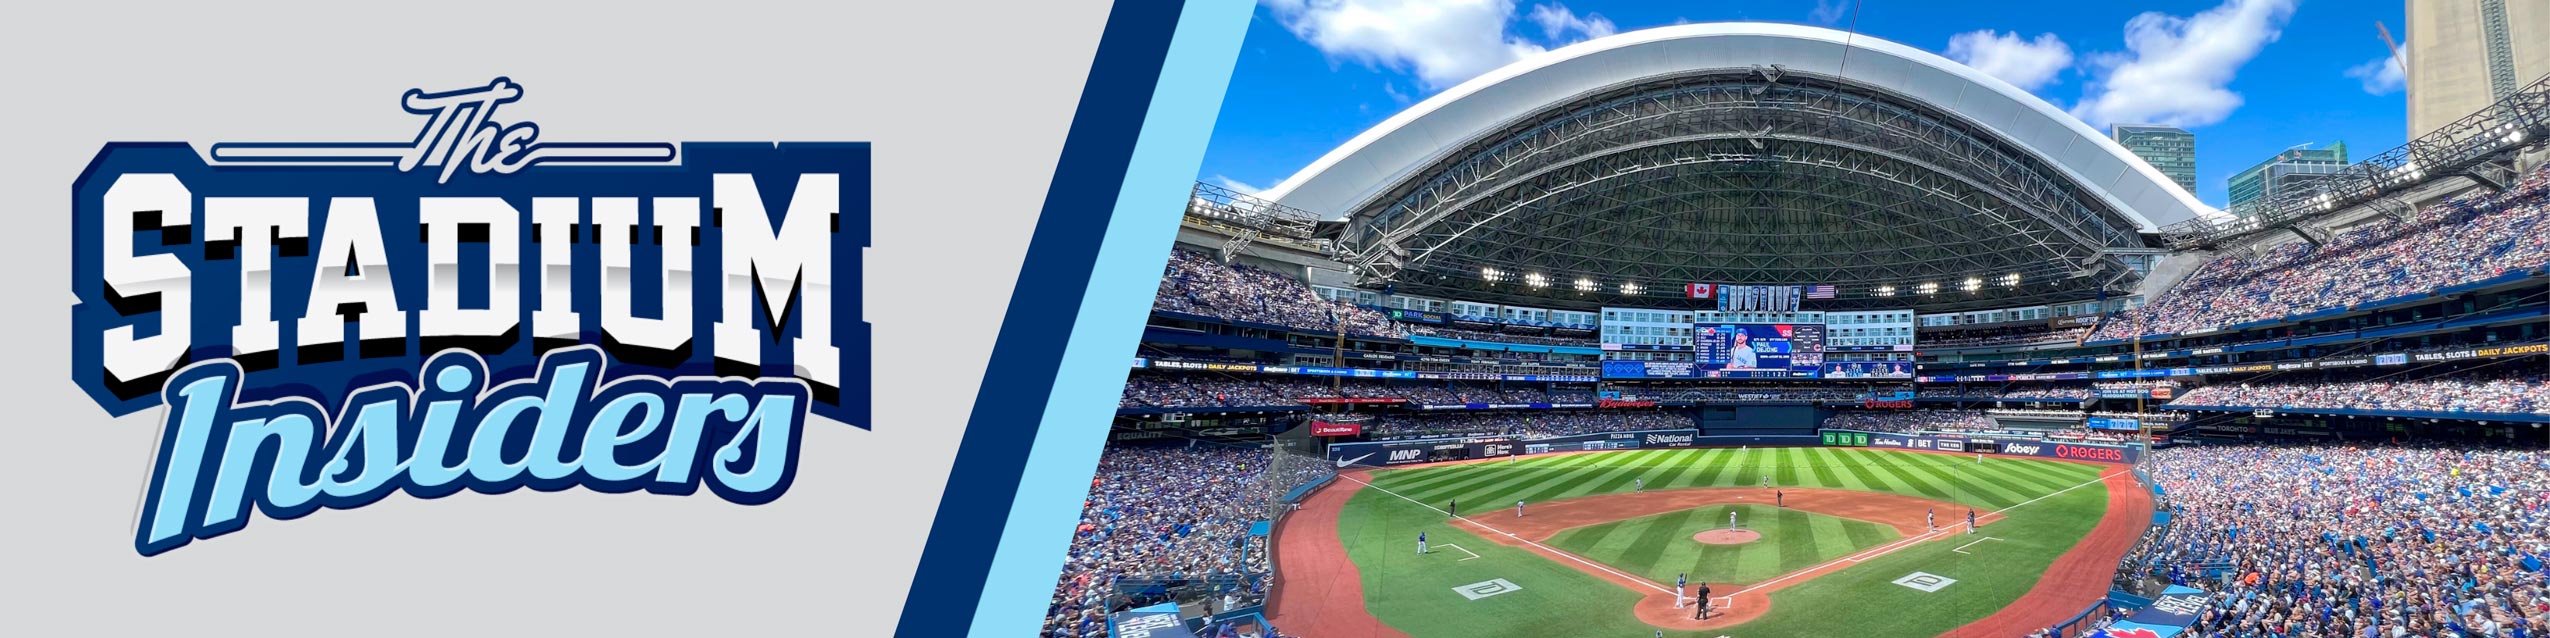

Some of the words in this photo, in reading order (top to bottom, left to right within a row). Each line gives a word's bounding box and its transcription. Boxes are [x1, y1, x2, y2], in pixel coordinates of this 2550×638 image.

[1403, 310, 1423, 319] PARK
[2076, 315, 2099, 323] ROOFTOP
[2415, 353, 2444, 361] TABLES,
[2446, 351, 2470, 359] SLOTS
[2478, 348, 2500, 357] DAILY
[2502, 344, 2548, 355] JACKPOTS
[1155, 361, 1181, 369] TABLES,
[1875, 400, 1912, 409] ROGERS
[2217, 425, 2248, 433] TORONTO
[1117, 431, 1164, 440] EQUALITY
[1656, 434, 1693, 443] National
[1884, 438, 1901, 446] Hortons
[2004, 442, 2040, 455] Sobeys
[1389, 449, 1421, 461] MNP
[2071, 446, 2122, 461] ROGERS
